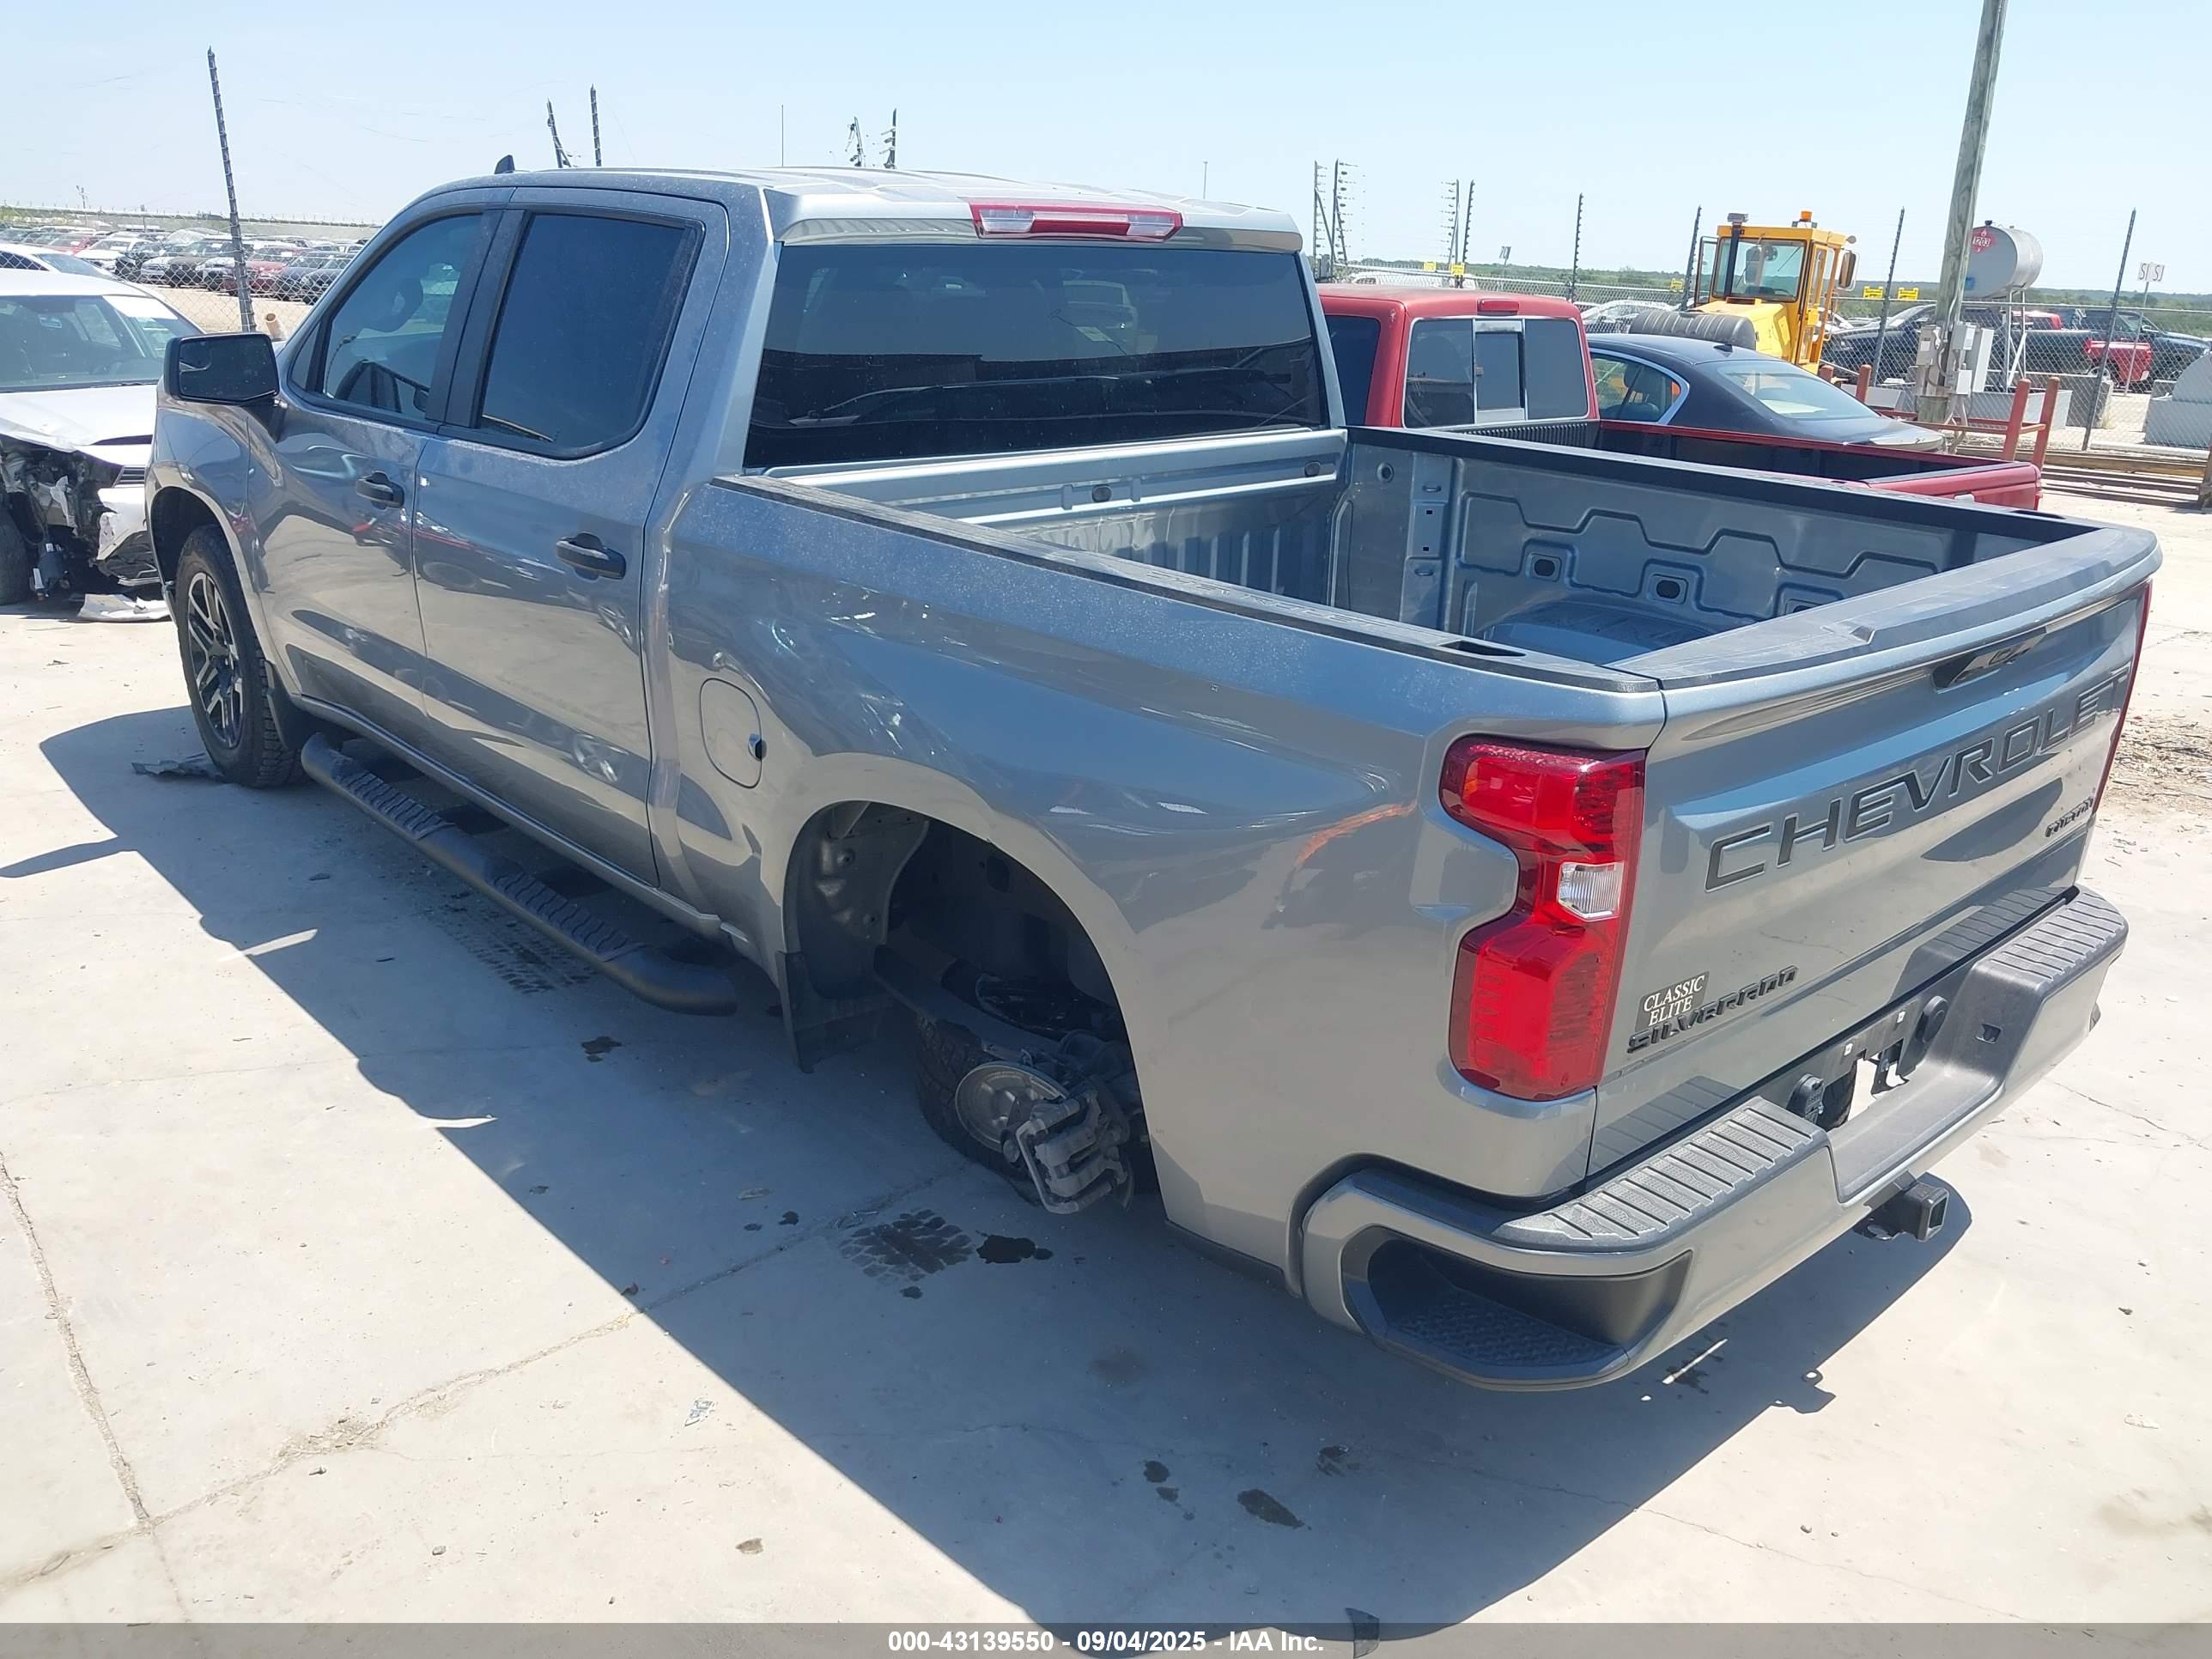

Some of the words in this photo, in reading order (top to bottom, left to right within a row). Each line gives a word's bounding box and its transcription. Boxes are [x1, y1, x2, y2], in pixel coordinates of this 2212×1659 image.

[1972, 235, 1991, 246] 1203
[1705, 665, 2131, 893] CHEVROLET
[1626, 964, 1799, 1054] SILVERADO
[1644, 975, 1705, 1012] CLASSIC
[1648, 995, 1694, 1026] ELITE
